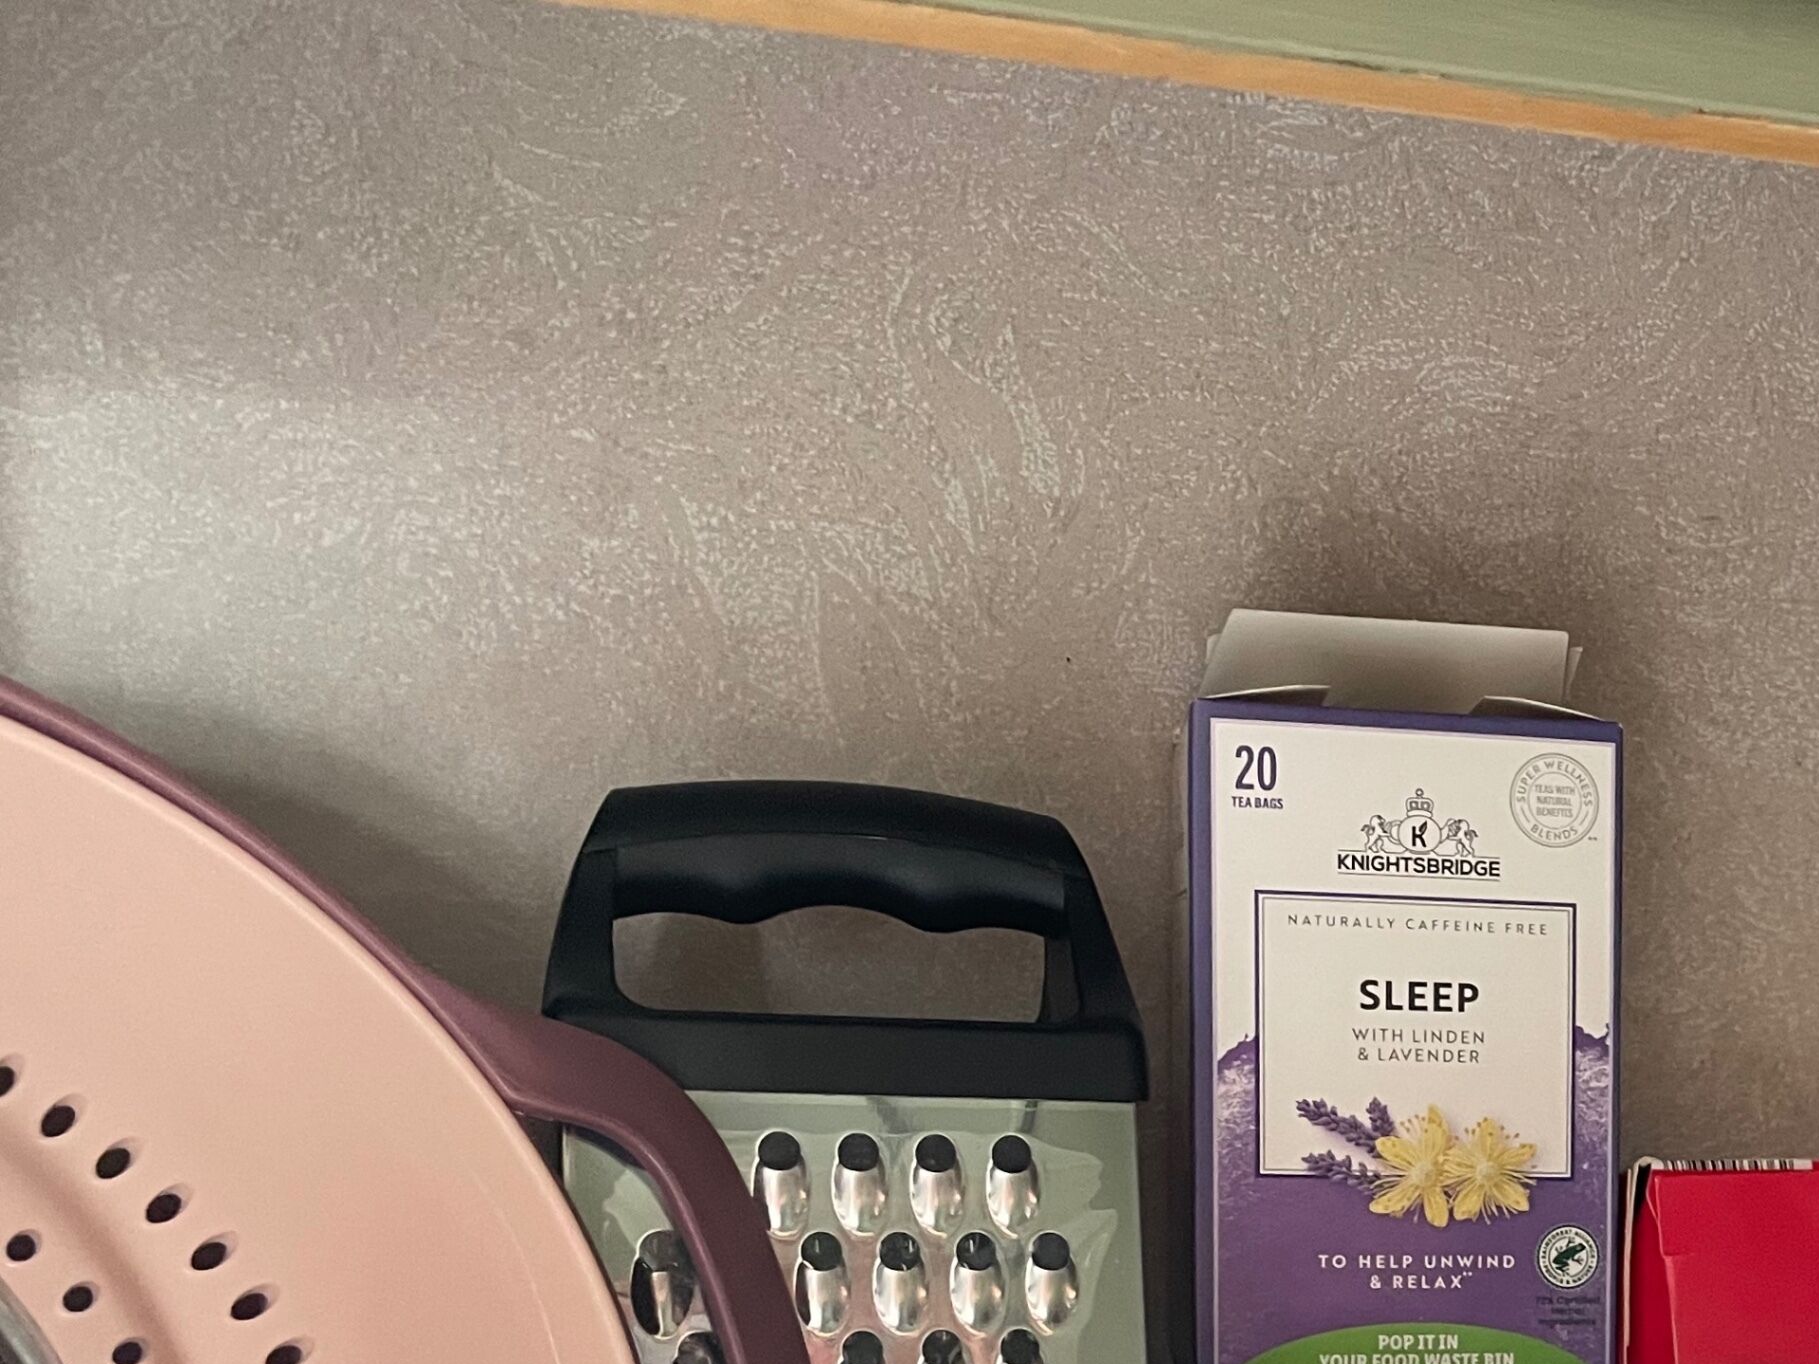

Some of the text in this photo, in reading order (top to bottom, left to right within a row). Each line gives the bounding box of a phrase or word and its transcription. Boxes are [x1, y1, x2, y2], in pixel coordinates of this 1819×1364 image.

[1234, 744, 1277, 791] 20
[1516, 759, 1593, 807] SUPER WELLNESS
[1231, 795, 1284, 809] TEA BAGS
[1530, 823, 1578, 840] BLENDS
[1337, 853, 1501, 877] KNIGHTSBRIDGE
[1288, 914, 1549, 936] NATURALLY CAFFEINE FREE
[1359, 979, 1480, 1013] SLEEP
[1352, 1027, 1486, 1045] WITH LINDEN
[1358, 1047, 1480, 1064] & LAVENDER
[1318, 1254, 1516, 1270] TO HELP UNWIND
[1370, 1274, 1382, 1290] &
[1378, 1334, 1459, 1350] POP IT IN
